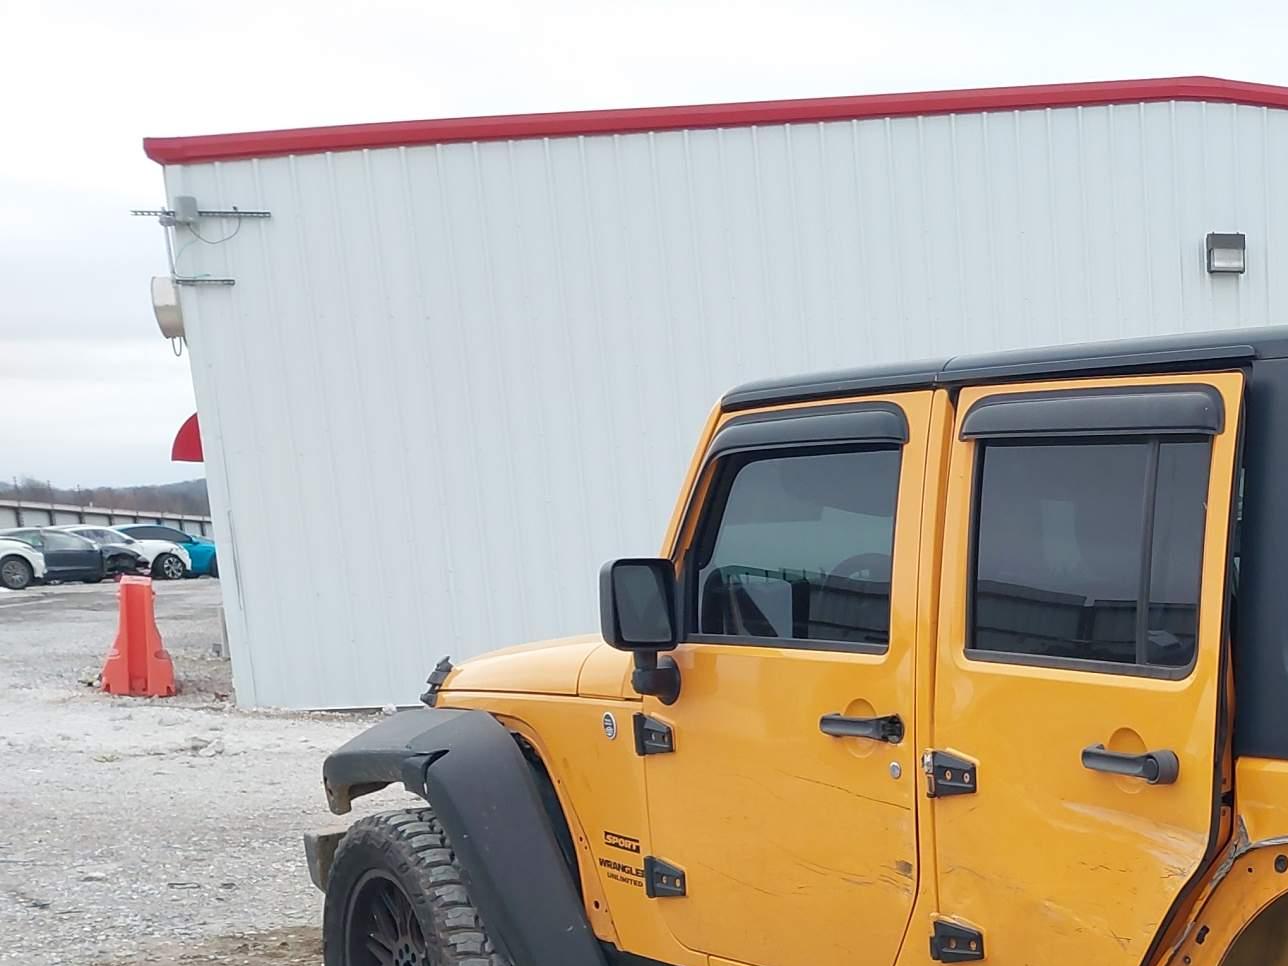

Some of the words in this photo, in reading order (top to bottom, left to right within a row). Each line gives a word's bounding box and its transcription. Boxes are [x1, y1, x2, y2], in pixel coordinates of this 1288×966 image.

[605, 833, 639, 851] SPORT
[598, 857, 645, 878] WRANGLE
[606, 871, 644, 888] UNLIMITED
